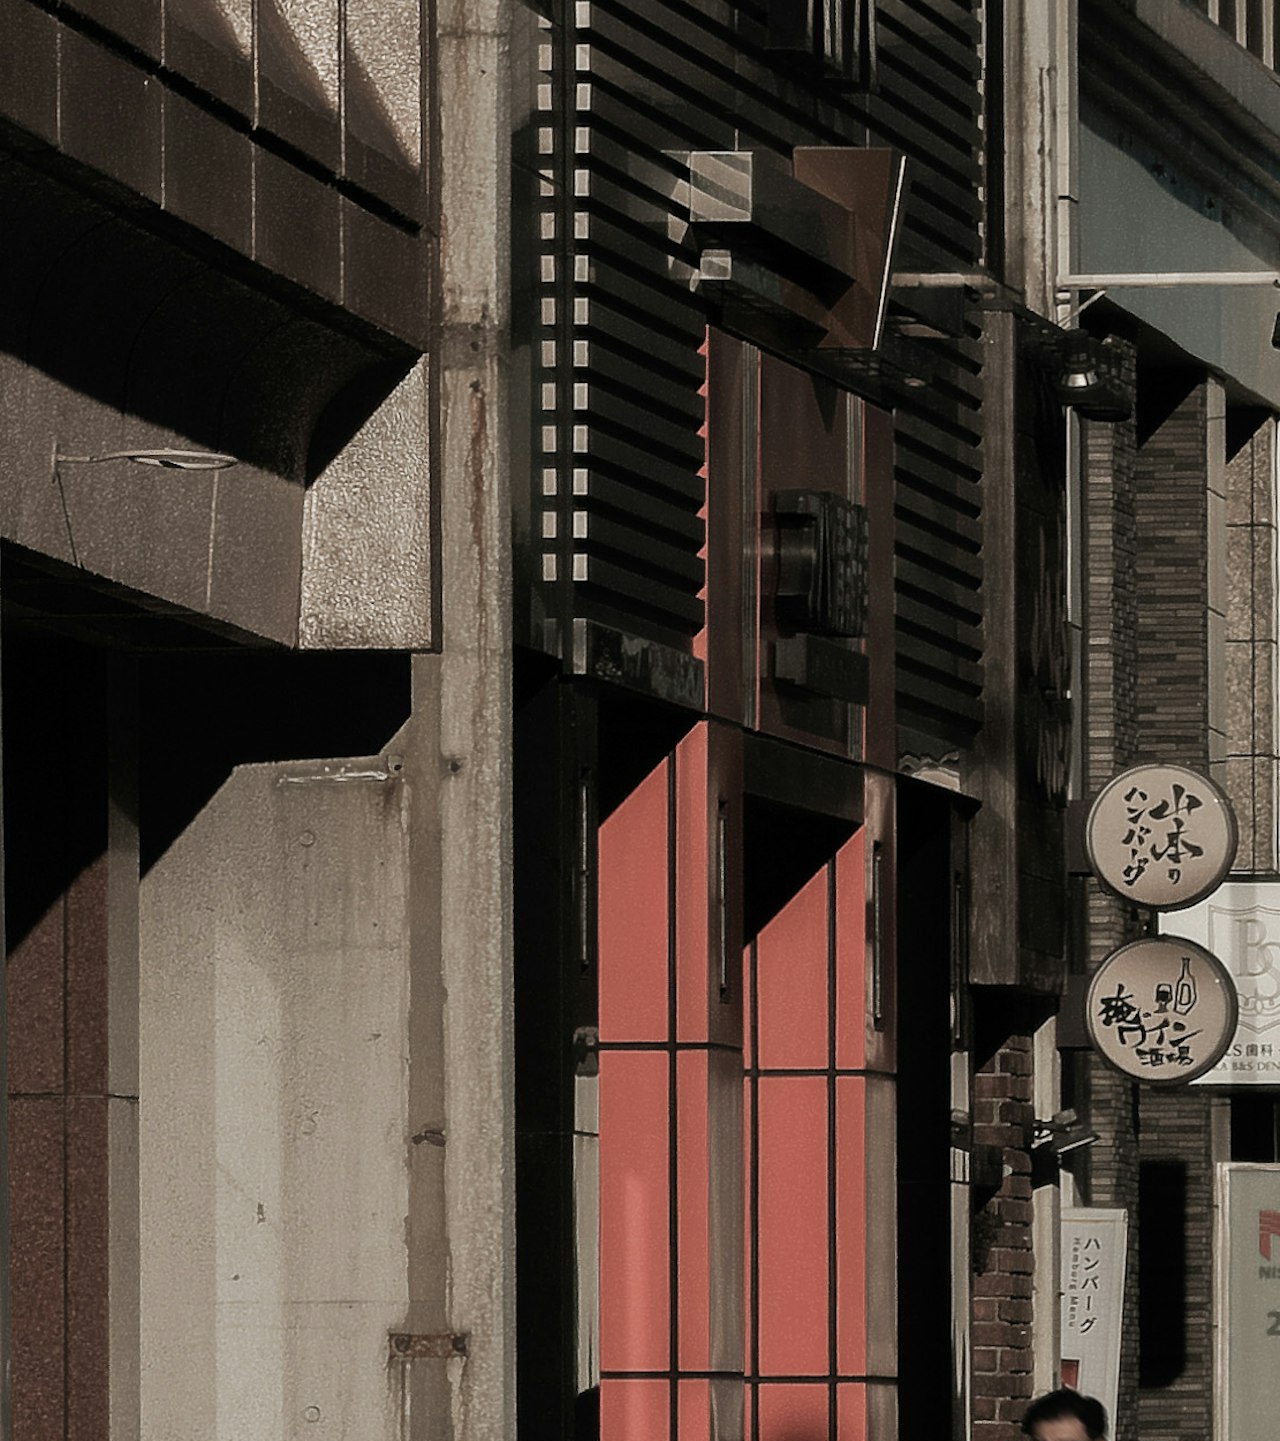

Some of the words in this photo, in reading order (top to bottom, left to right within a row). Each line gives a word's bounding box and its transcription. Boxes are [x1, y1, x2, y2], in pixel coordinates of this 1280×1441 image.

[1122, 787, 1151, 886] ハンバーグ
[1080, 1237, 1101, 1334] ハンバーグ
